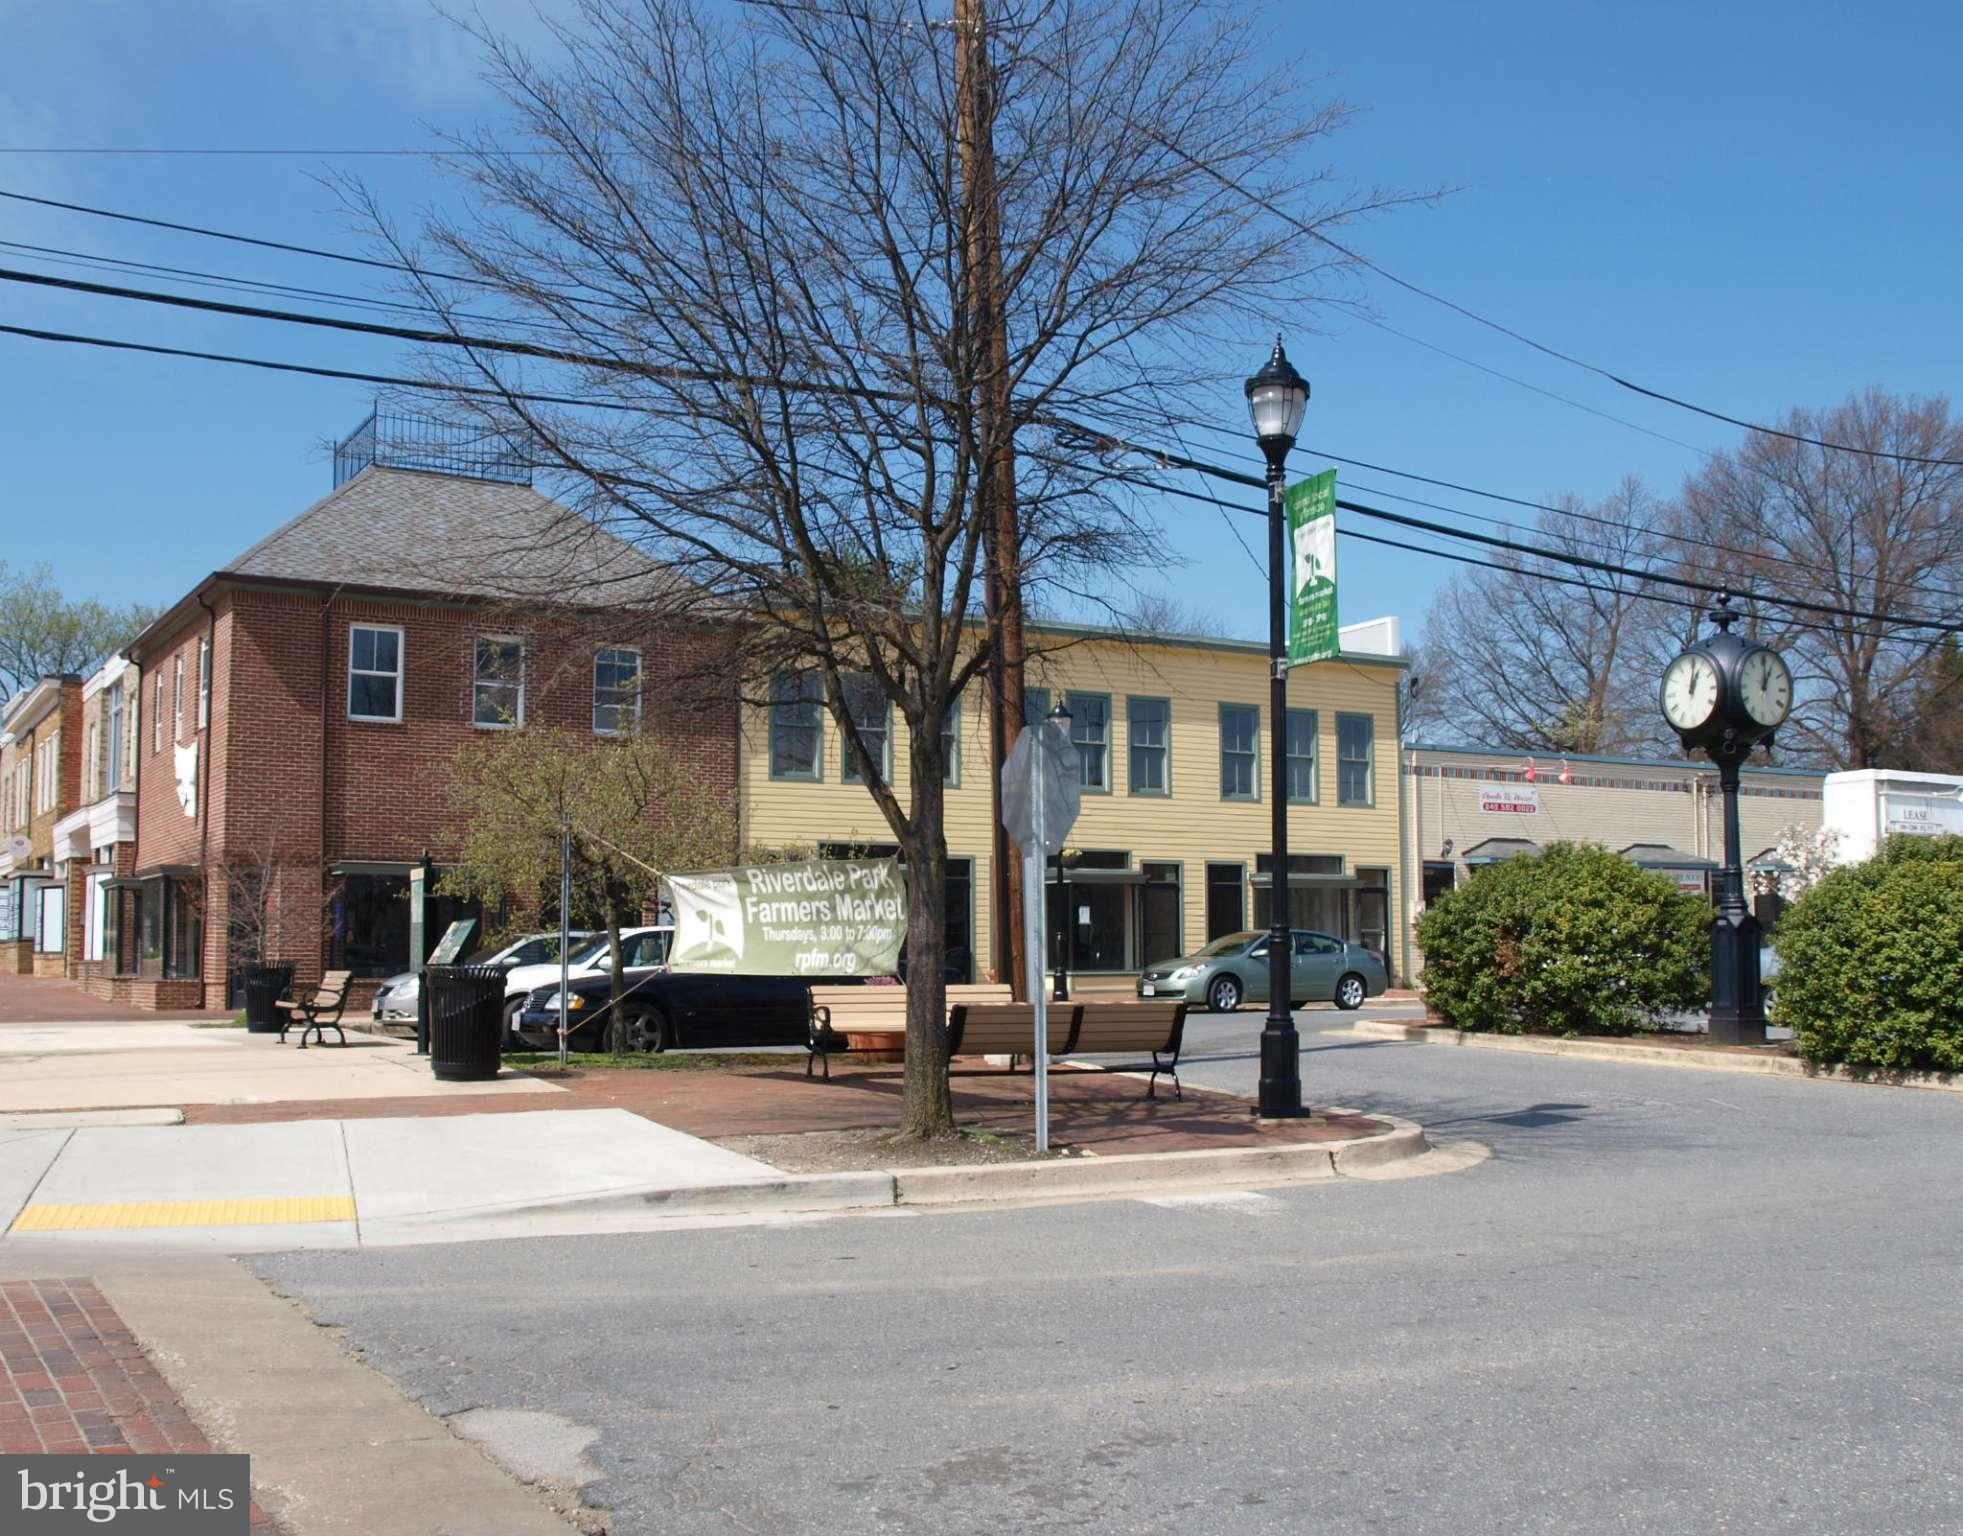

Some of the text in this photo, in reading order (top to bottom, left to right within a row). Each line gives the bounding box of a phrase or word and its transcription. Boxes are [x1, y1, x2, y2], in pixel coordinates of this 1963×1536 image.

[1903, 809, 1928, 820] LEASE
[746, 861, 895, 894] Riverdale Park
[745, 892, 905, 923] Farmers Market
[762, 925, 893, 944] Thursdays, 3:00 to 7:00pm
[794, 948, 857, 974] rpfm.org
